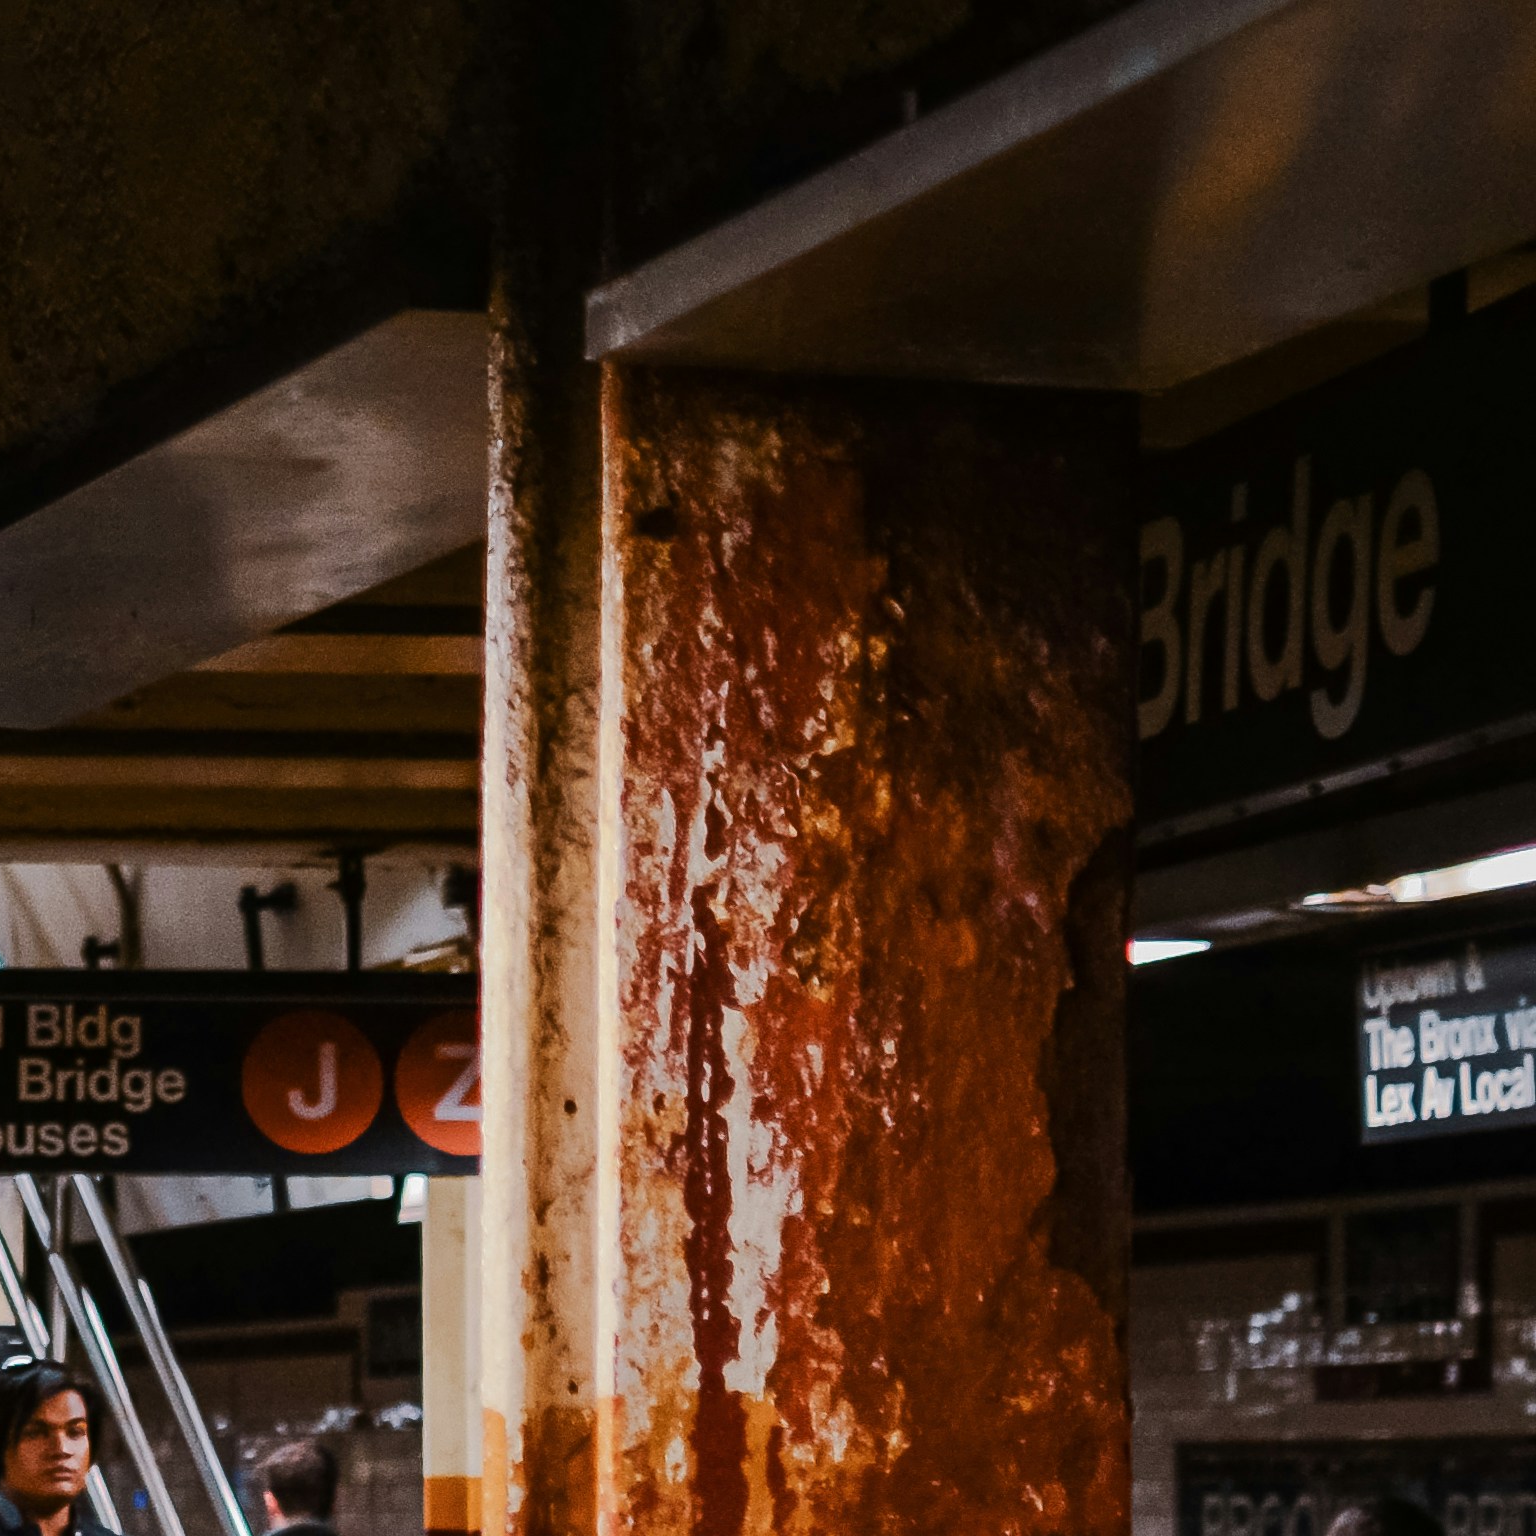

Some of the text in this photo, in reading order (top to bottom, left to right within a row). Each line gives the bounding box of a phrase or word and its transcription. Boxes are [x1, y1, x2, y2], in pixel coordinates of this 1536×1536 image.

[1137, 454, 1441, 741] Bridge
[27, 1003, 140, 1058] Bldg
[1363, 1016, 1416, 1071] The
[1419, 1008, 1499, 1064] Bronx
[18, 1056, 186, 1113] Bridge
[287, 1041, 337, 1121] J
[434, 1043, 482, 1121] Z
[1364, 1053, 1536, 1128] Lex Av Local
